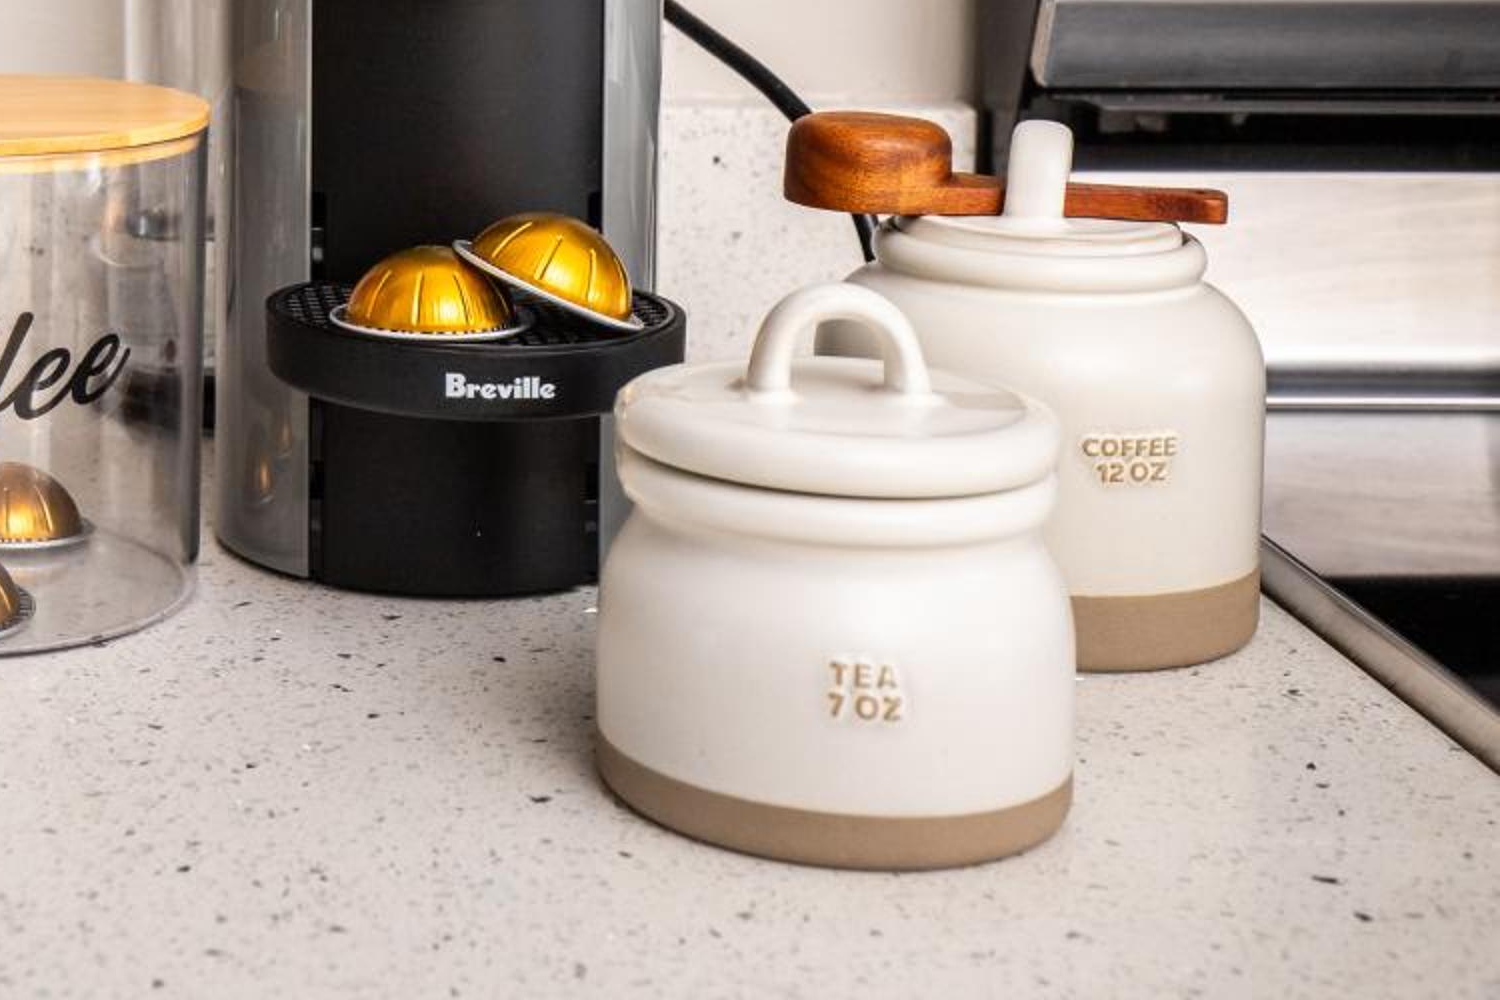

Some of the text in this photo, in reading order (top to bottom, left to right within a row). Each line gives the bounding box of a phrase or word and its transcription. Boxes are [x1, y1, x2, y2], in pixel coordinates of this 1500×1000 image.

[445, 372, 557, 399] Breville
[1081, 436, 1178, 457] COFFEE
[1096, 461, 1167, 484] 12 OZ
[829, 661, 898, 689] TEA
